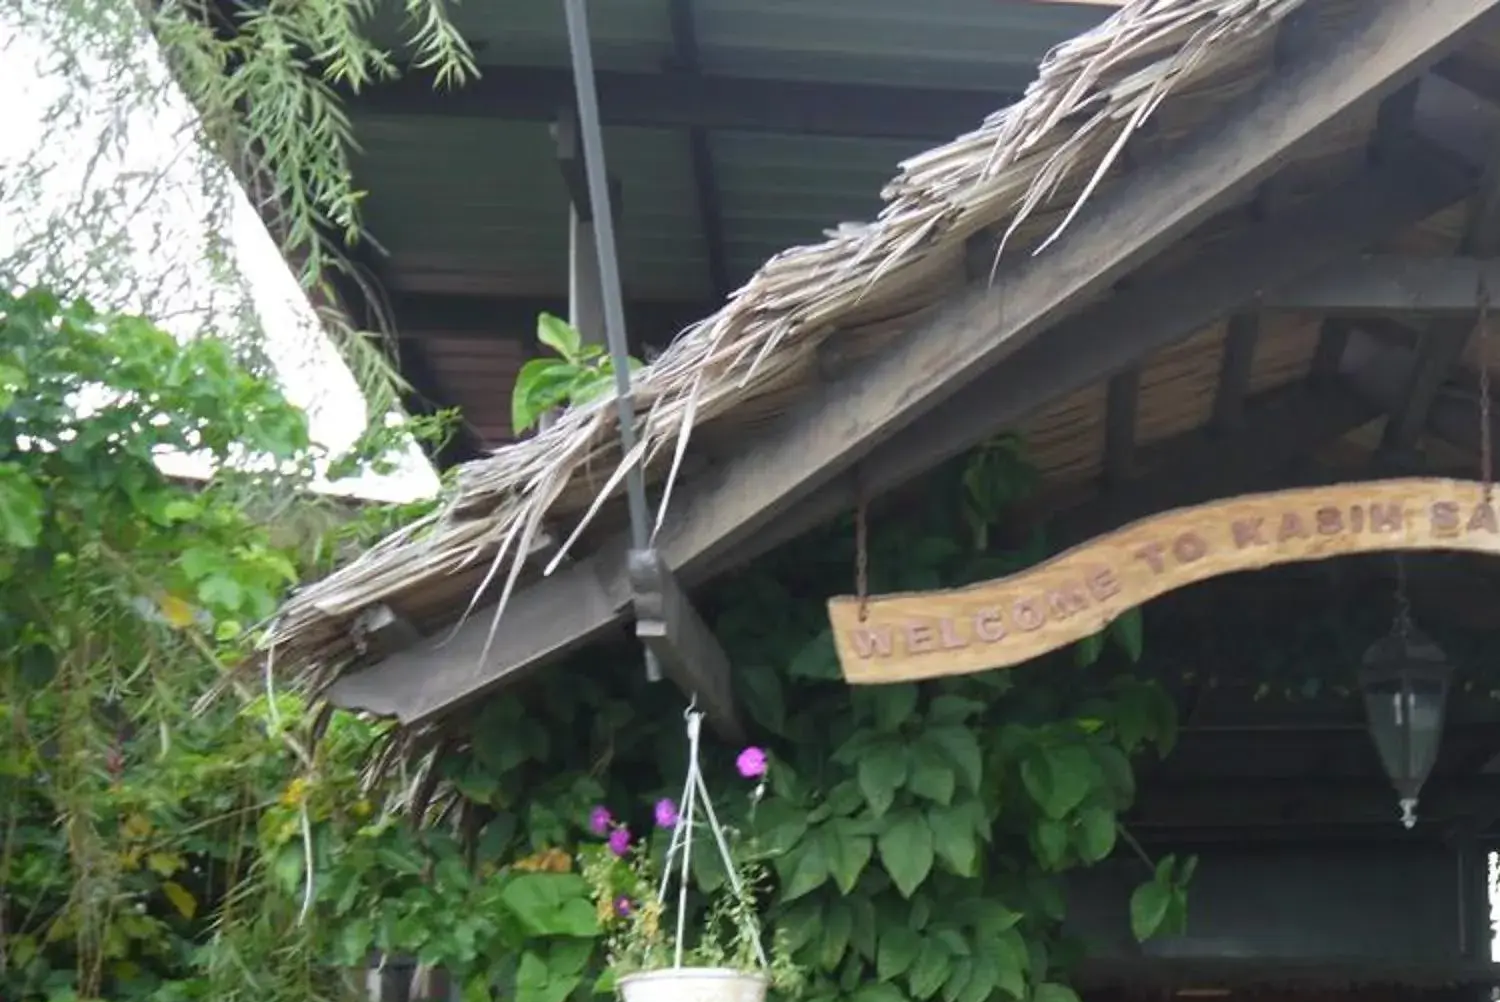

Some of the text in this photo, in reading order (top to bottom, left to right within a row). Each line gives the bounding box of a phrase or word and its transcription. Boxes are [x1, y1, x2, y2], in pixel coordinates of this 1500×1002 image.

[854, 568, 1122, 660] WELCOME
[1134, 530, 1207, 575] TO
[1230, 502, 1403, 549] KASIH
